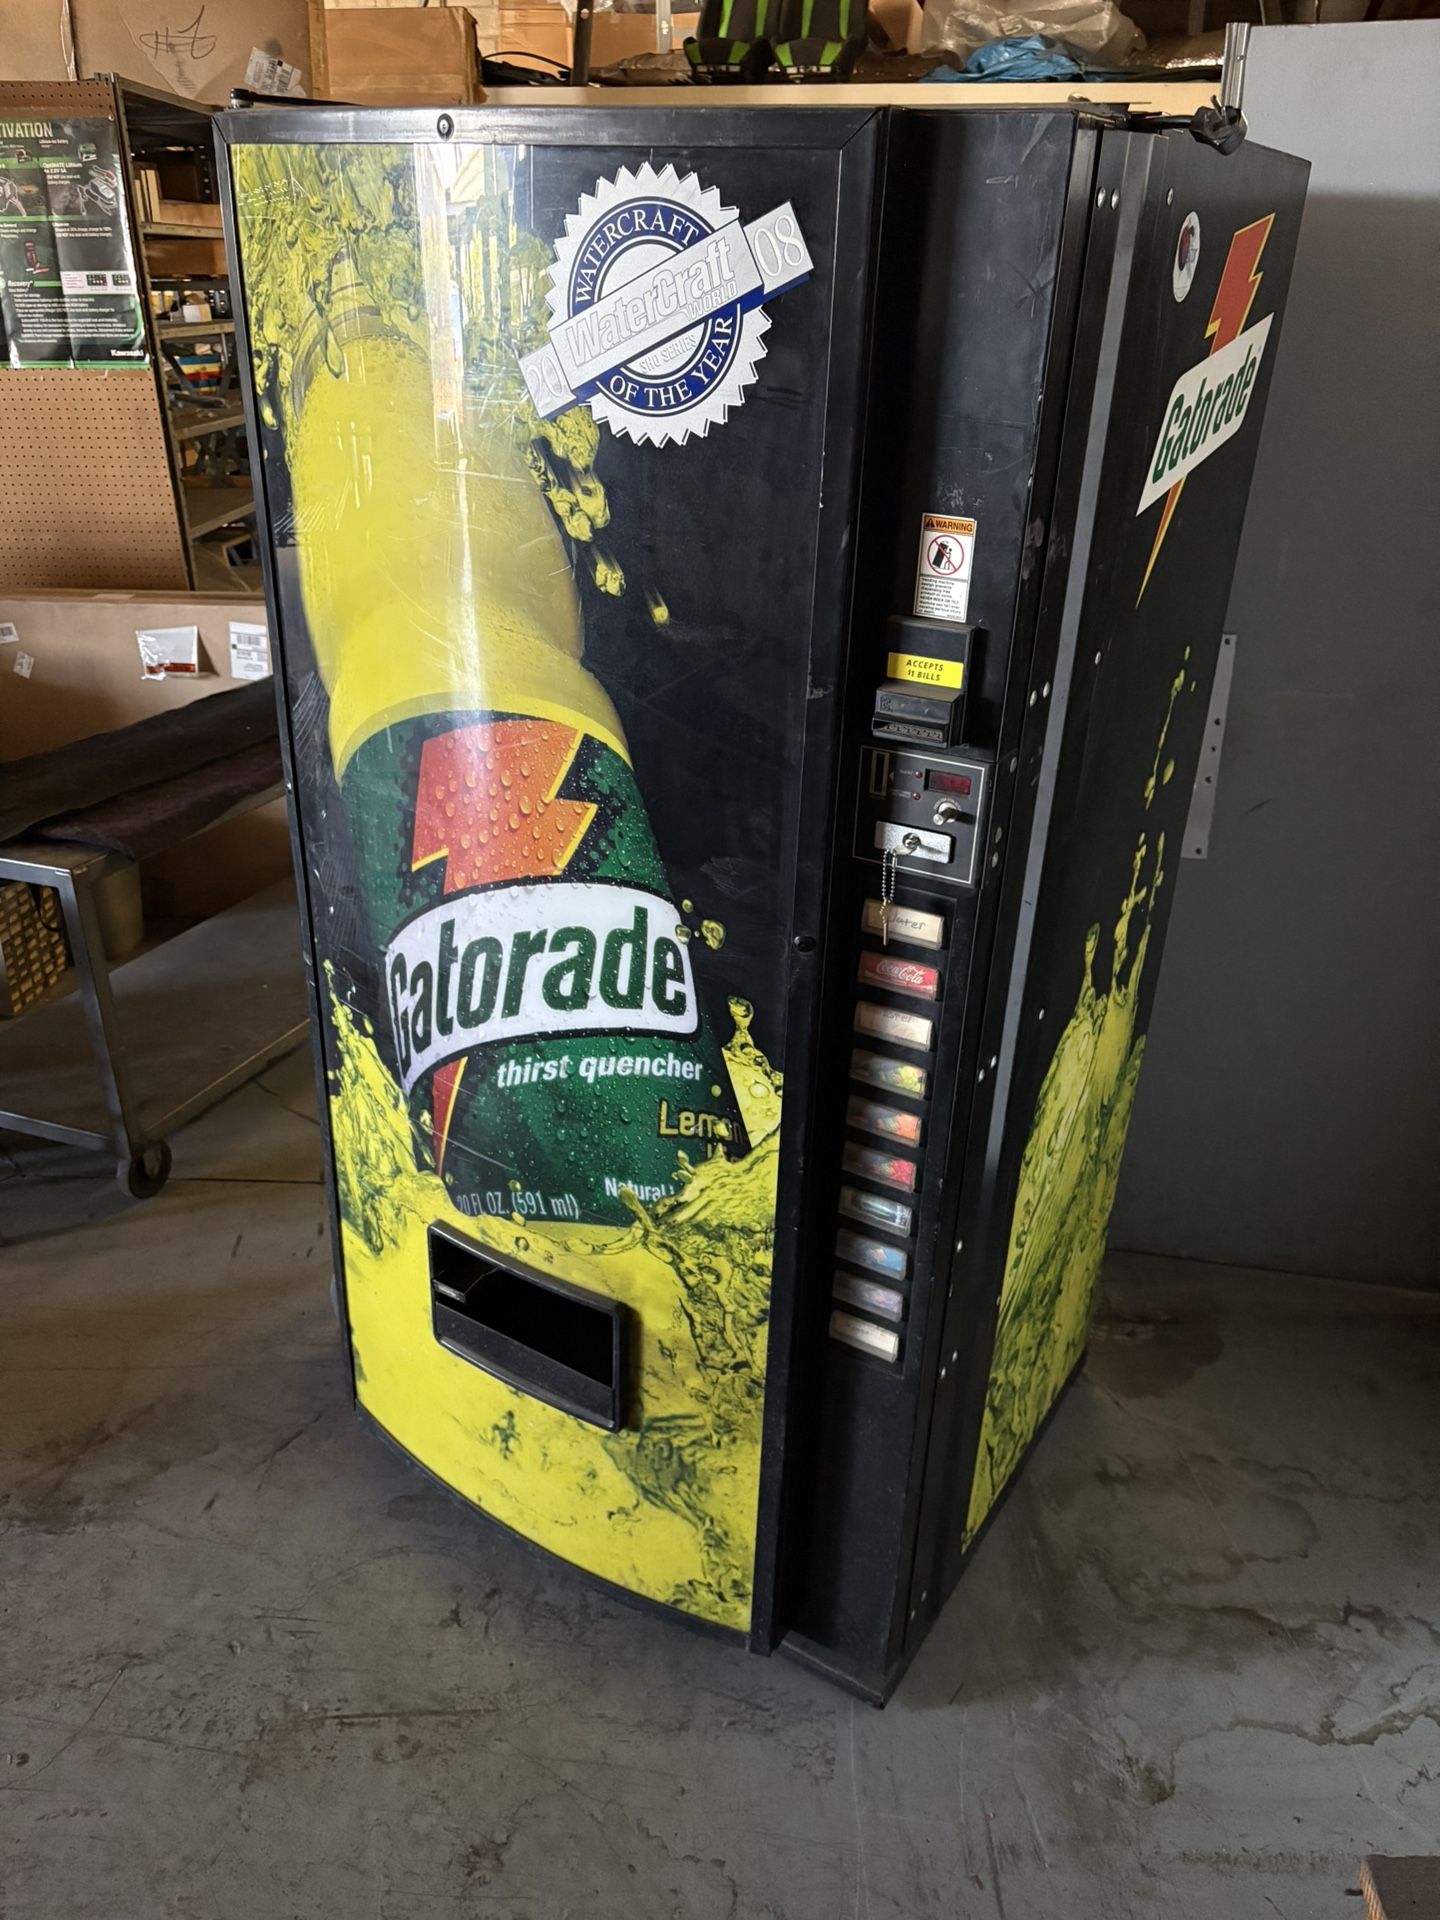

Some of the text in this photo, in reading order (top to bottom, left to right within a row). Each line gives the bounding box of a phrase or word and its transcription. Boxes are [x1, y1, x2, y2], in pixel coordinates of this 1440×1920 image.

[575, 209, 700, 304] WATERCRAFT
[754, 214, 805, 277] 08
[565, 236, 736, 368] WaterCraft
[688, 281, 738, 319] WORLD
[609, 316, 733, 408] OF THE YEAR
[661, 334, 697, 362] SERIES
[526, 354, 564, 409] 20
[1152, 343, 1257, 484] Gatorade
[935, 519, 973, 533] WARNING
[905, 659, 944, 672] ACCEPTS
[907, 669, 941, 682] $1 BILLS
[390, 905, 688, 1079] Gatorade
[496, 1052, 704, 1088] thirst quencher
[486, 1191, 510, 1215] OZ.
[511, 1190, 547, 1215] (591
[548, 1193, 580, 1220] ml)
